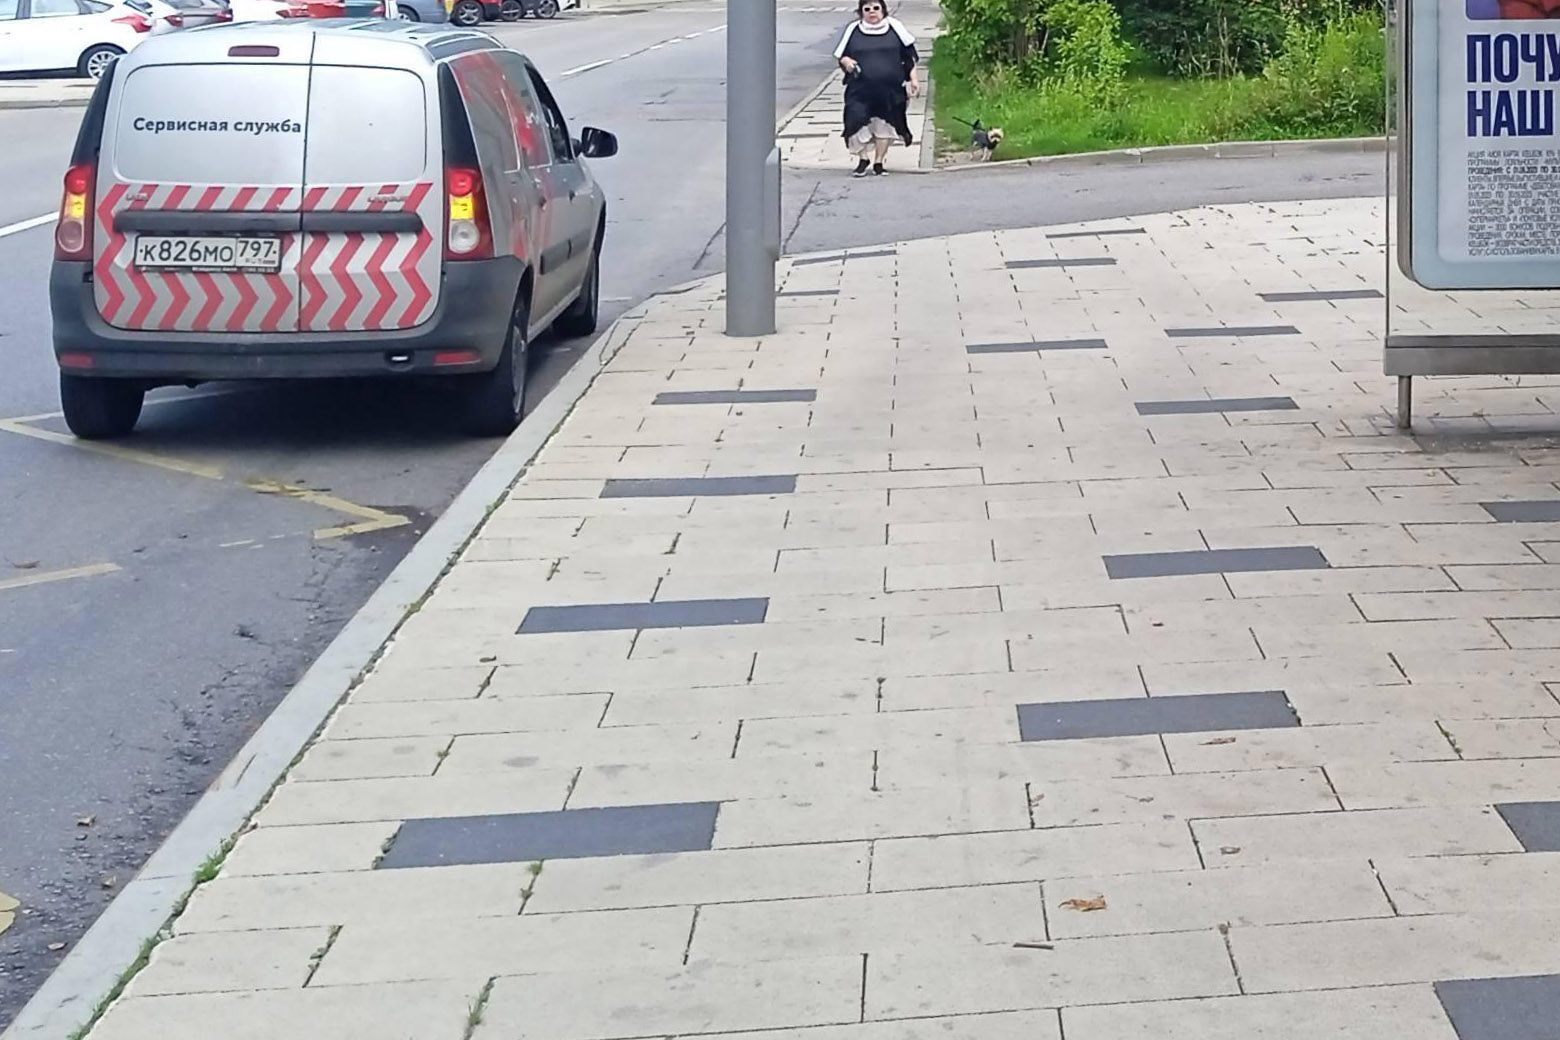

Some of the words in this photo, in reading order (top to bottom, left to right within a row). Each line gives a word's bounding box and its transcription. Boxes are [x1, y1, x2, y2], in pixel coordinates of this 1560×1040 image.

[134, 117, 228, 134] Сервисная
[234, 118, 301, 134] служба
[1467, 90, 1553, 137] НАШ
